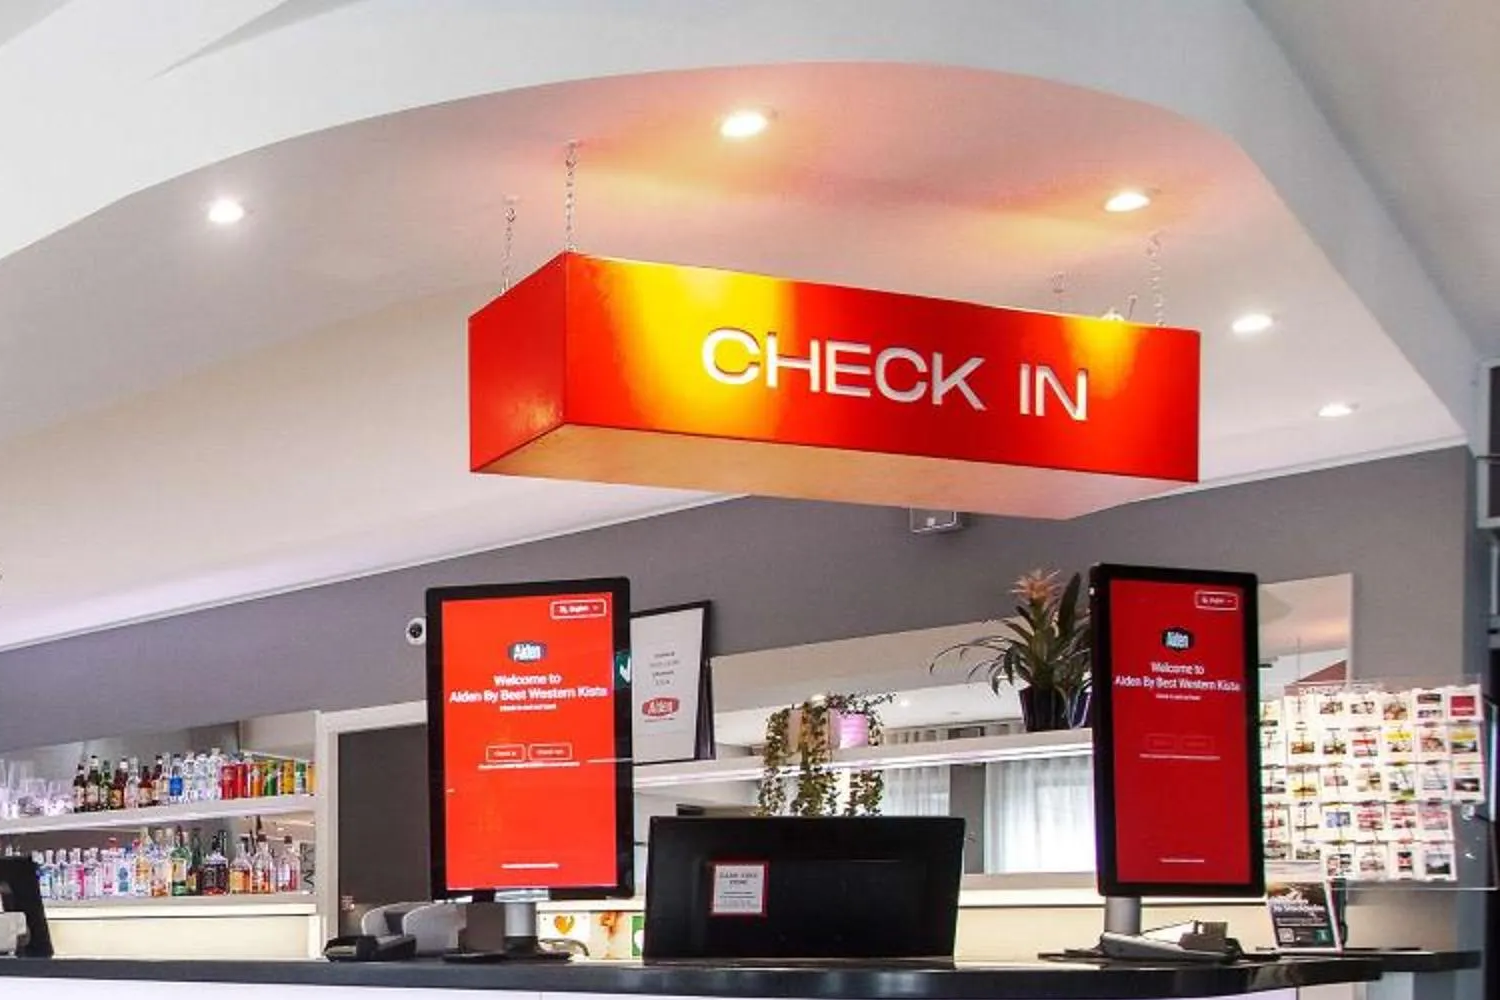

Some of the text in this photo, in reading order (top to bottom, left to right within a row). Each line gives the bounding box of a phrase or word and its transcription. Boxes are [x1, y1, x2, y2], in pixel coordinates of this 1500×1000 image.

[701, 327, 1088, 421] CHECK IN
[493, 673, 562, 686] Welcome to
[450, 691, 482, 703] Aiden
[484, 690, 499, 703] By
[501, 689, 526, 701] Best
[529, 687, 577, 699] Western
